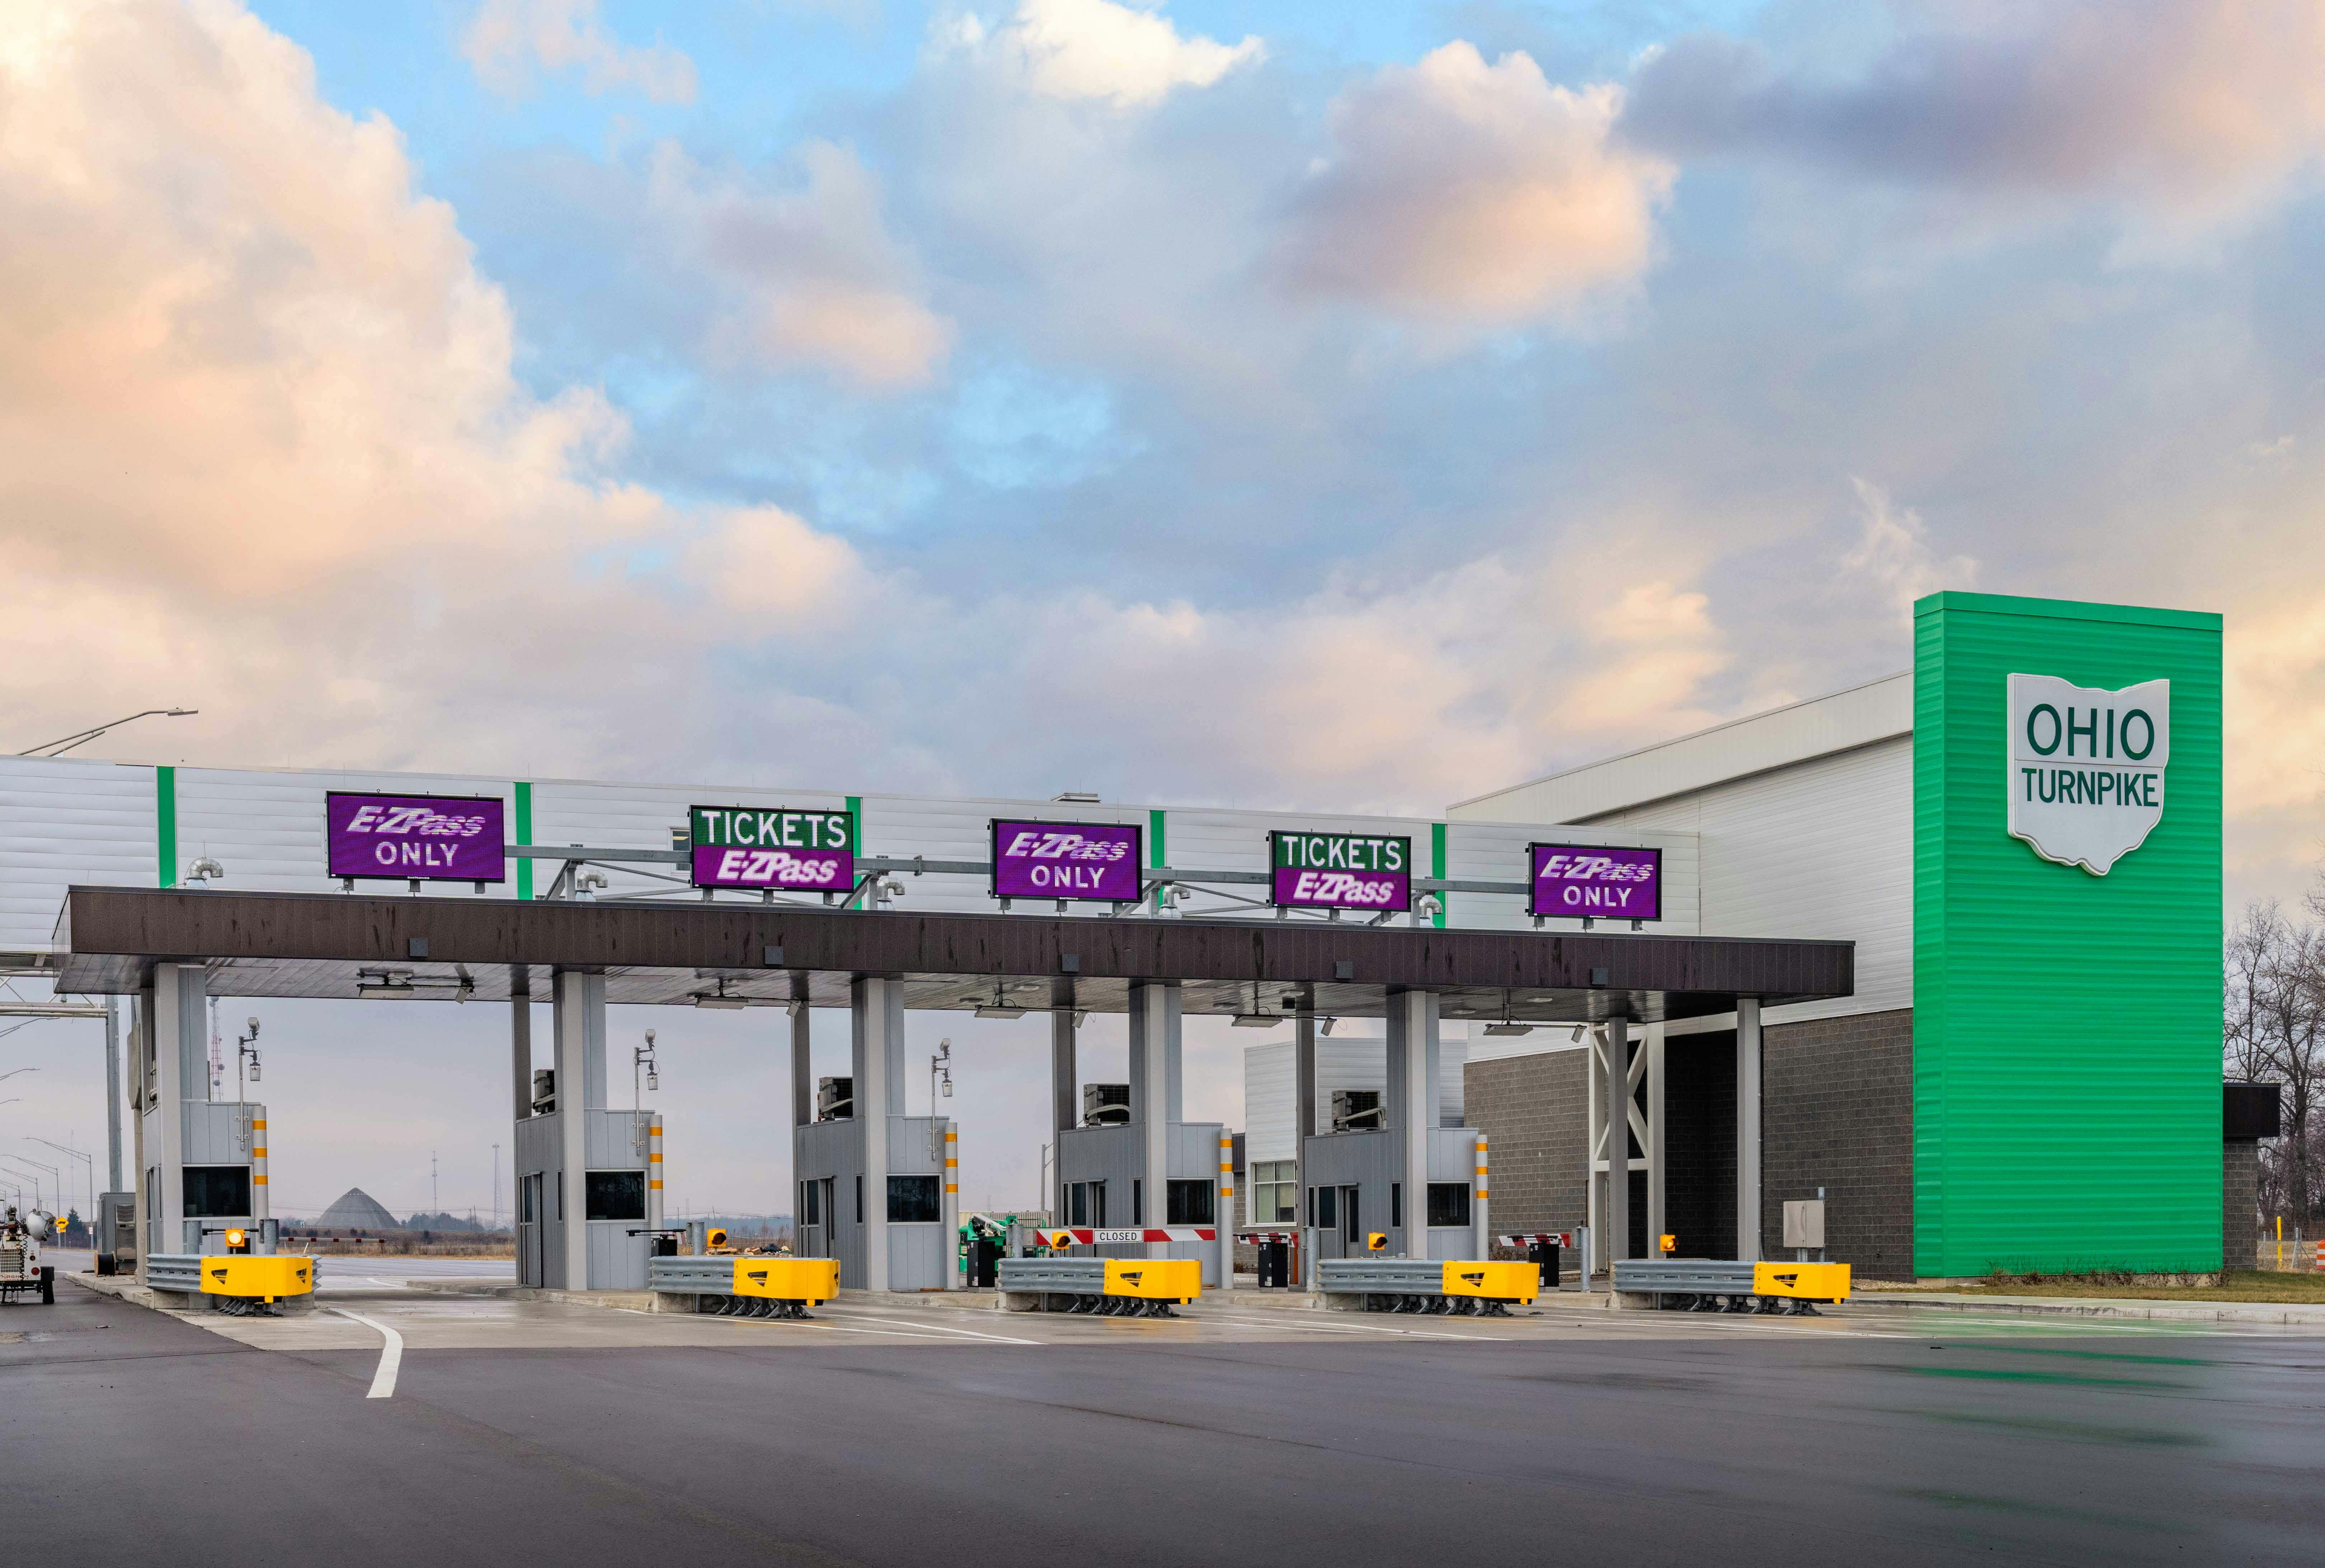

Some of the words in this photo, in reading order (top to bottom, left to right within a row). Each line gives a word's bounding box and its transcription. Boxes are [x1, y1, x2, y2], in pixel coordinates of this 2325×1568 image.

[2027, 703, 2154, 760] OHIO
[2022, 768, 2159, 807] TURNPIKE
[701, 811, 846, 848] TICKETS
[375, 842, 459, 866] ONLY
[1282, 836, 1401, 870] TICKETS
[1031, 865, 1105, 888] ONLY
[1563, 886, 1632, 907] ONLY
